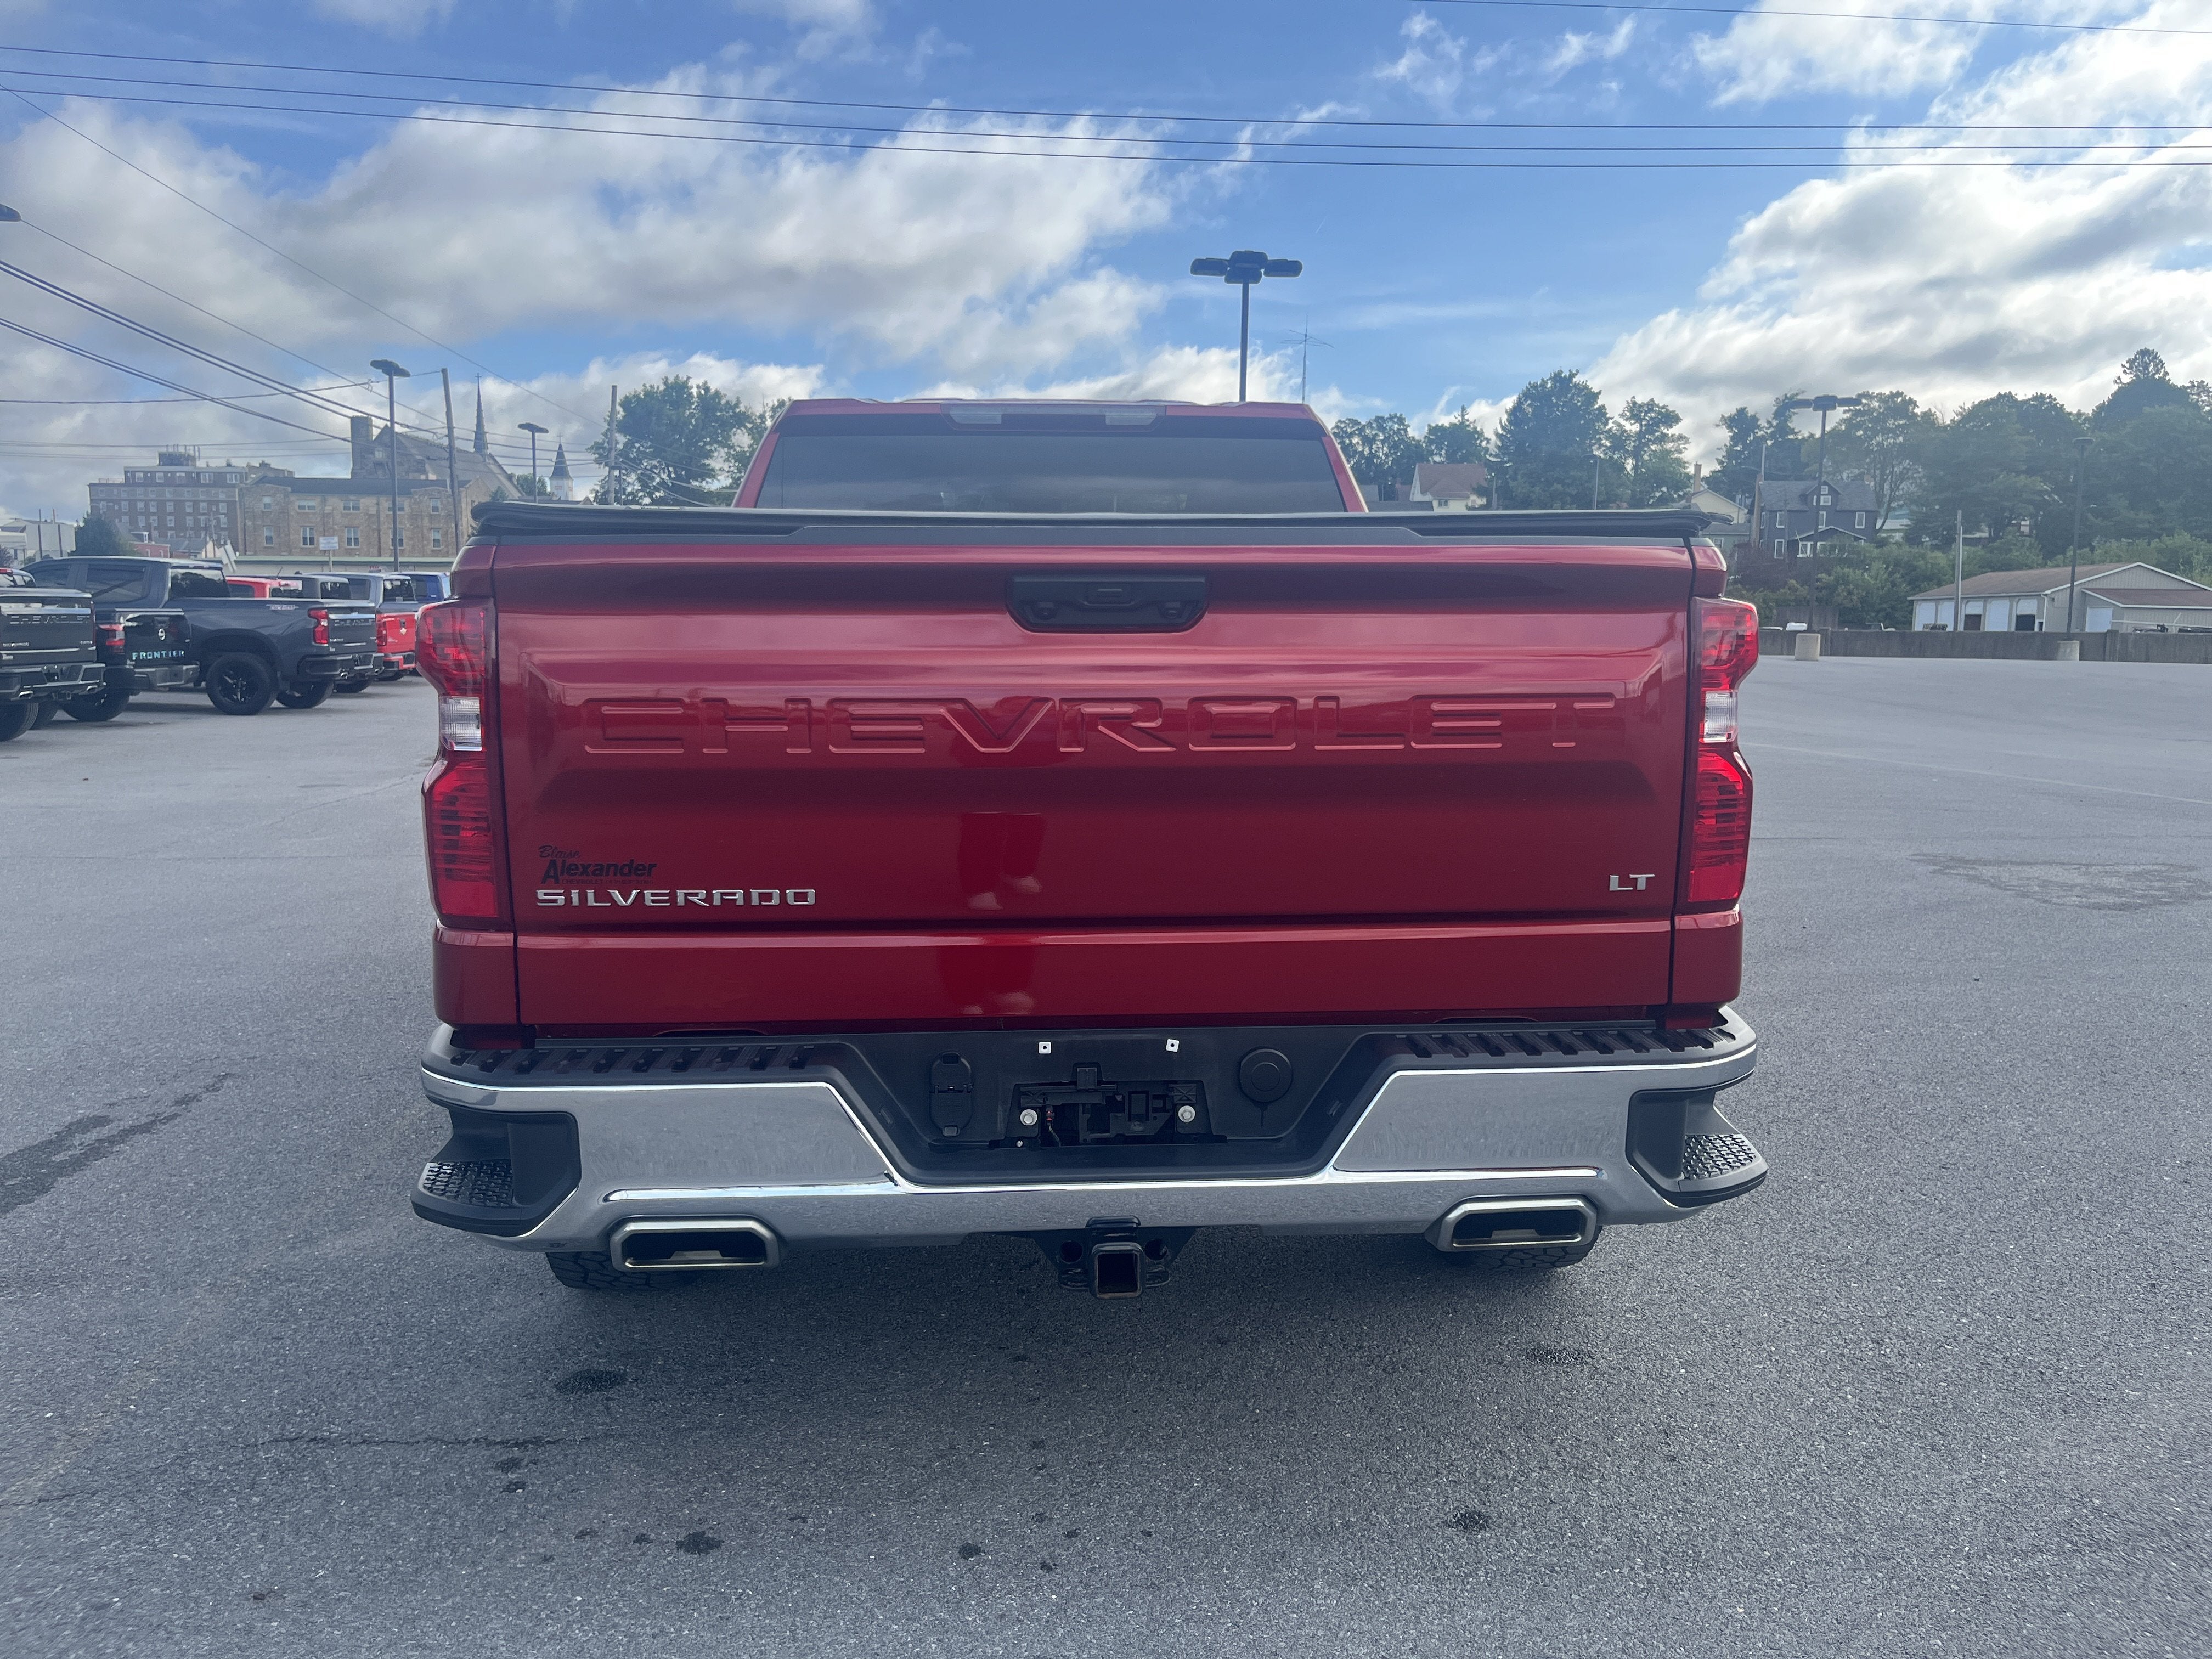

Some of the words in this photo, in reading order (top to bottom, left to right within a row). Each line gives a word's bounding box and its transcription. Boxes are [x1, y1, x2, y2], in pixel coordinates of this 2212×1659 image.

[132, 650, 184, 660] FRONTIER
[583, 692, 1618, 754] CHEVROLET
[541, 859, 657, 884] Alexander
[1609, 874, 1655, 891] LT
[535, 889, 816, 906] SILVERADO
